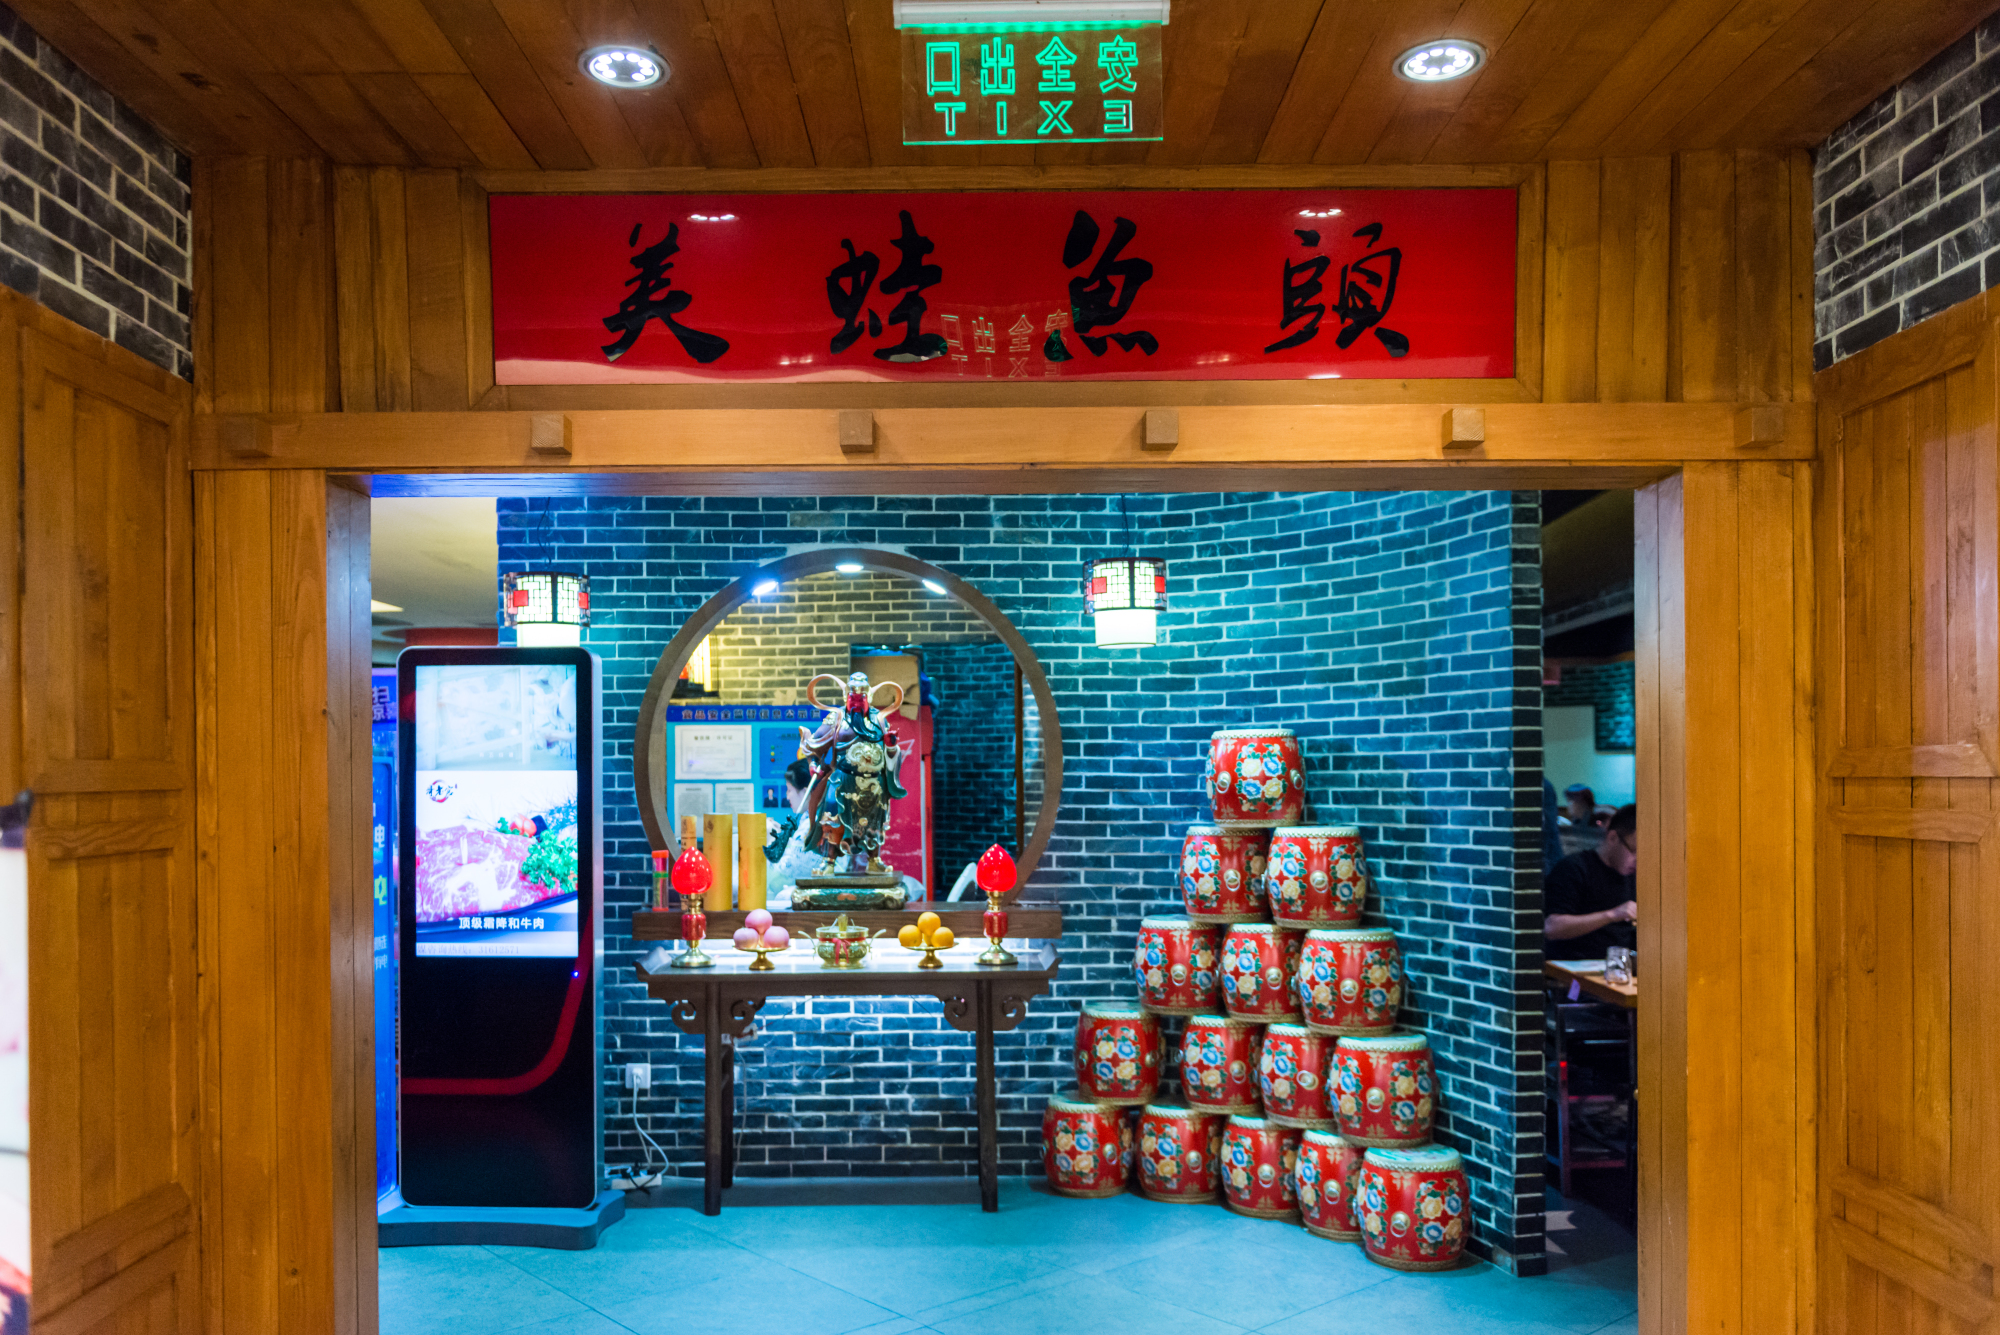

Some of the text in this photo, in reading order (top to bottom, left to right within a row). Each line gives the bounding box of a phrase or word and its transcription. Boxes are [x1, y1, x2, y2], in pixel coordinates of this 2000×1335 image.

[458, 917, 545, 930] 顶级霜降和牛肉
